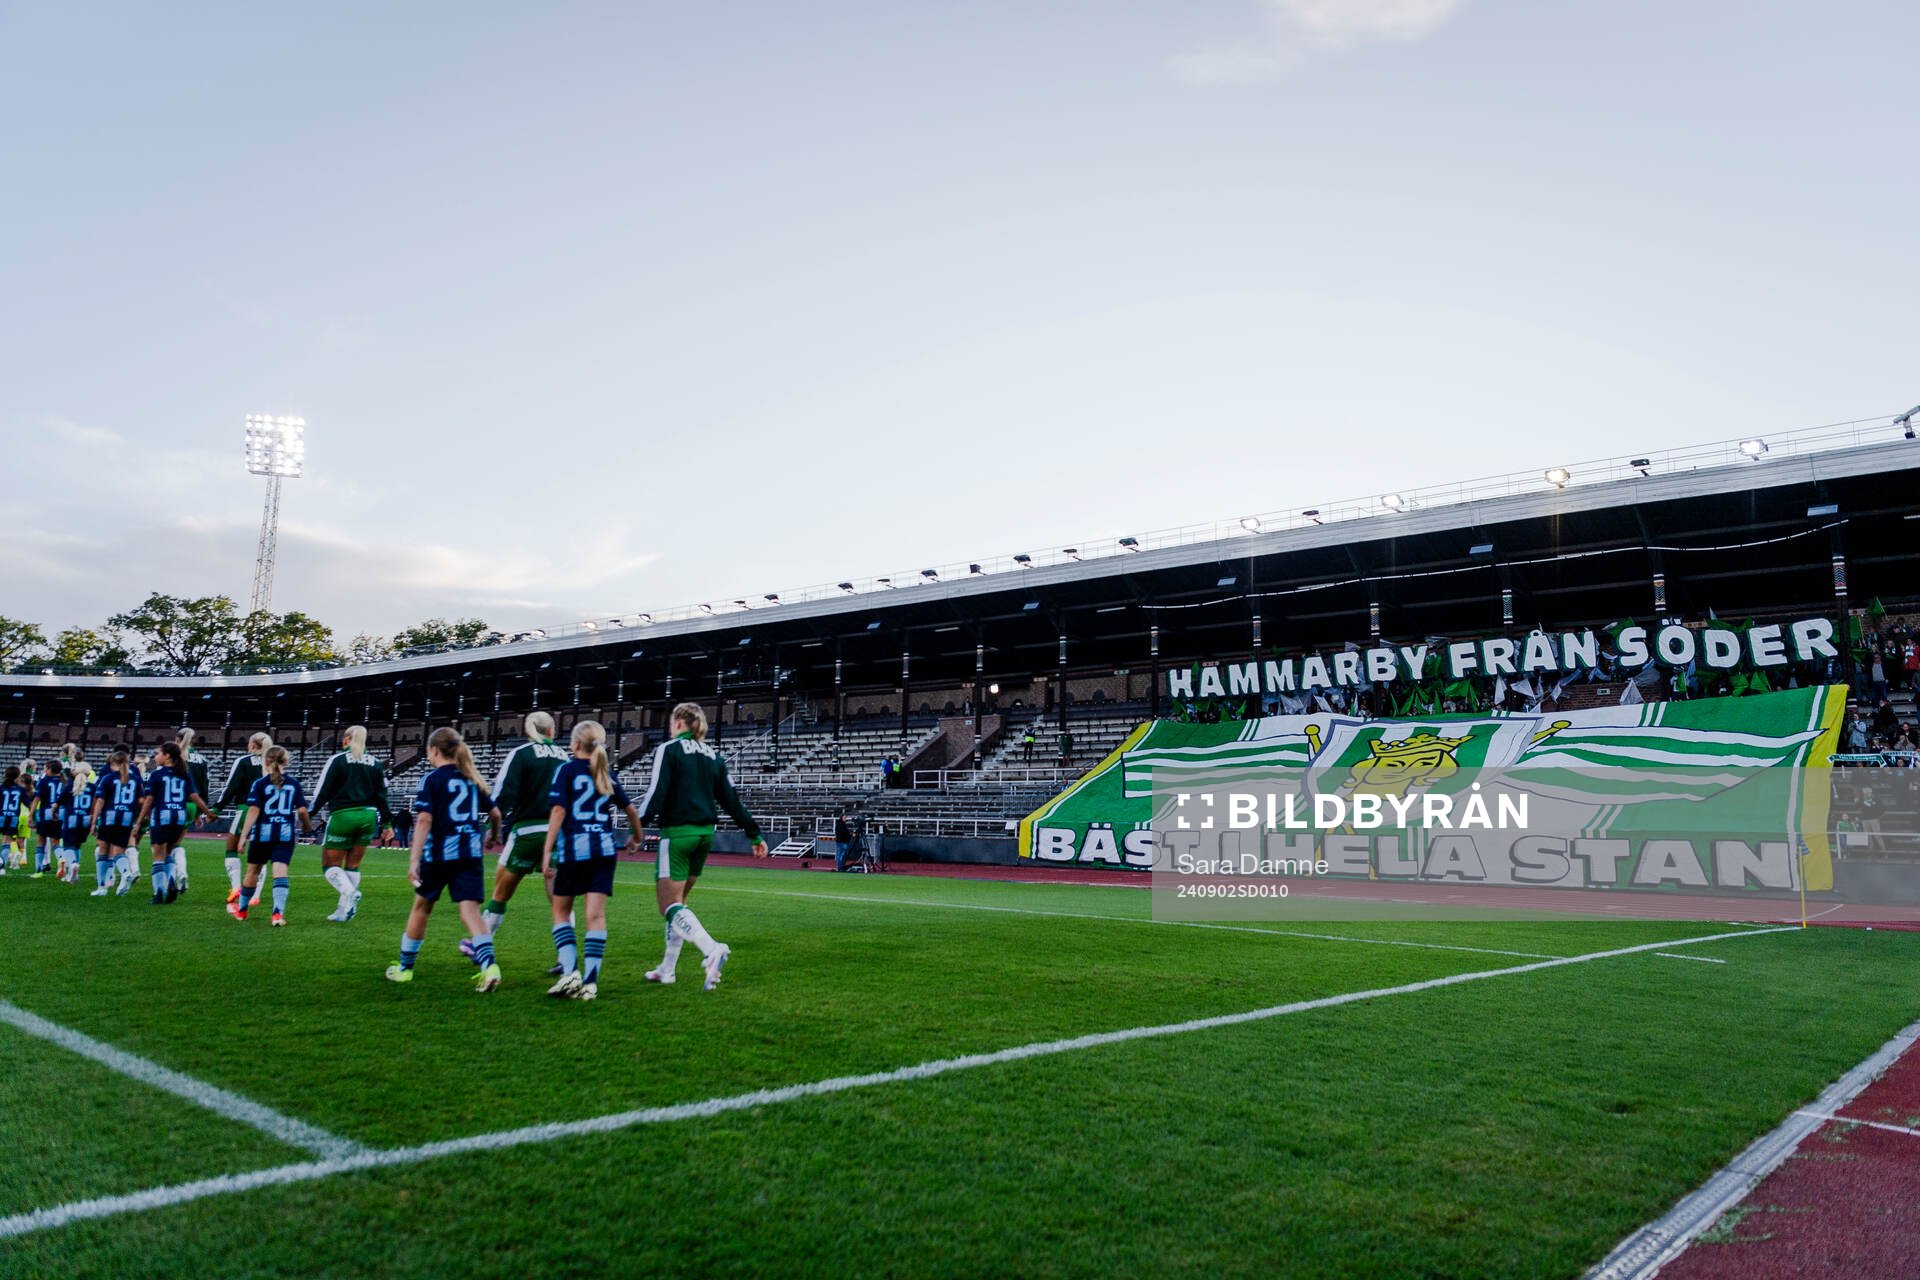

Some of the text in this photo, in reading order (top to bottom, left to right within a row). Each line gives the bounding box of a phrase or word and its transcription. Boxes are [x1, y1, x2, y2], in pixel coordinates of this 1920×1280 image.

[1169, 616, 1839, 698] HAMMARBY FRÅN SÖDER
[2, 790, 21, 811] 13
[112, 778, 137, 805] 18
[162, 775, 185, 803] 19
[264, 784, 295, 815] 20
[447, 778, 479, 822] 21
[270, 815, 288, 823] TCL
[1035, 821, 1201, 871] BÄST
[1265, 829, 1487, 881] HELA
[1509, 834, 1795, 889] STAN
